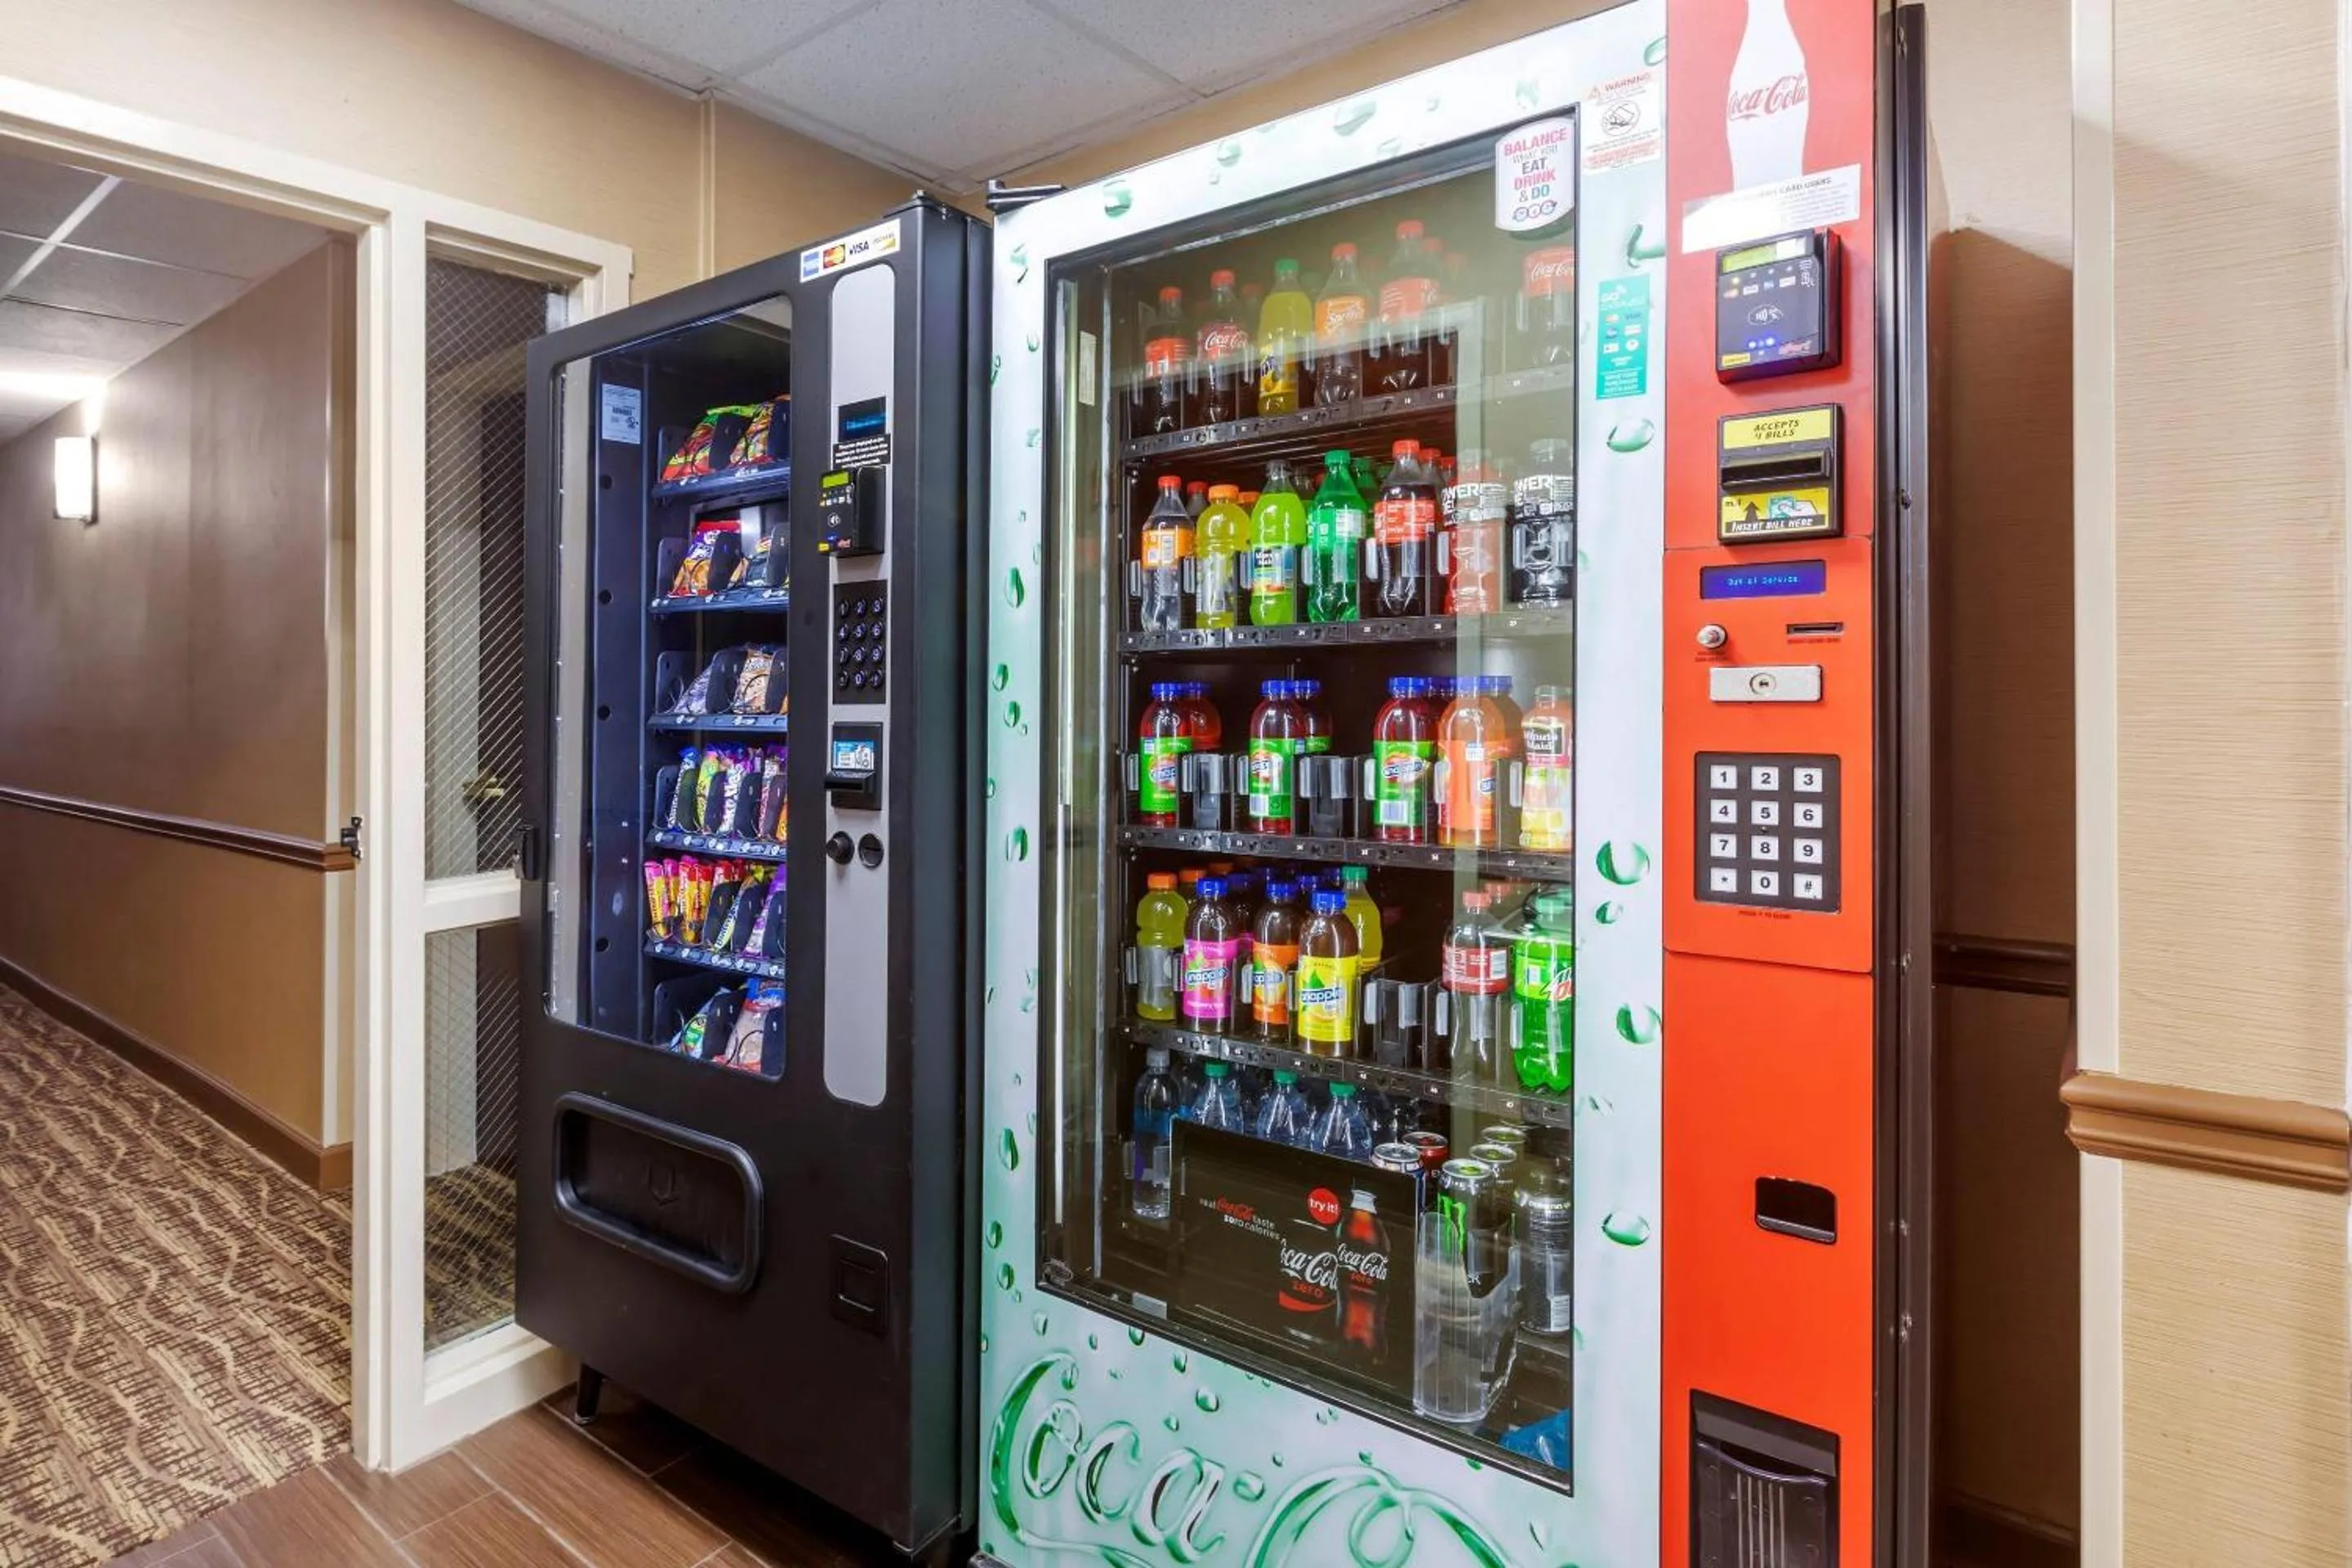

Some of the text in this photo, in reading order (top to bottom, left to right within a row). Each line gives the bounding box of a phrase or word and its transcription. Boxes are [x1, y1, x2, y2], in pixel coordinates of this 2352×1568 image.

[1503, 127, 1568, 156] BALANCE
[1513, 167, 1556, 190] DRINK
[1519, 184, 1551, 203] & DO
[849, 240, 870, 256] VISA
[1754, 419, 1800, 432] ACCEPTS
[1720, 771, 1814, 786] 1 2 3
[1719, 805, 1814, 822] 4 5 6
[1719, 839, 1814, 857] 7 8 9
[1760, 876, 1771, 889] 0
[1803, 880, 1813, 890] #
[1309, 1197, 1339, 1214] try it!
